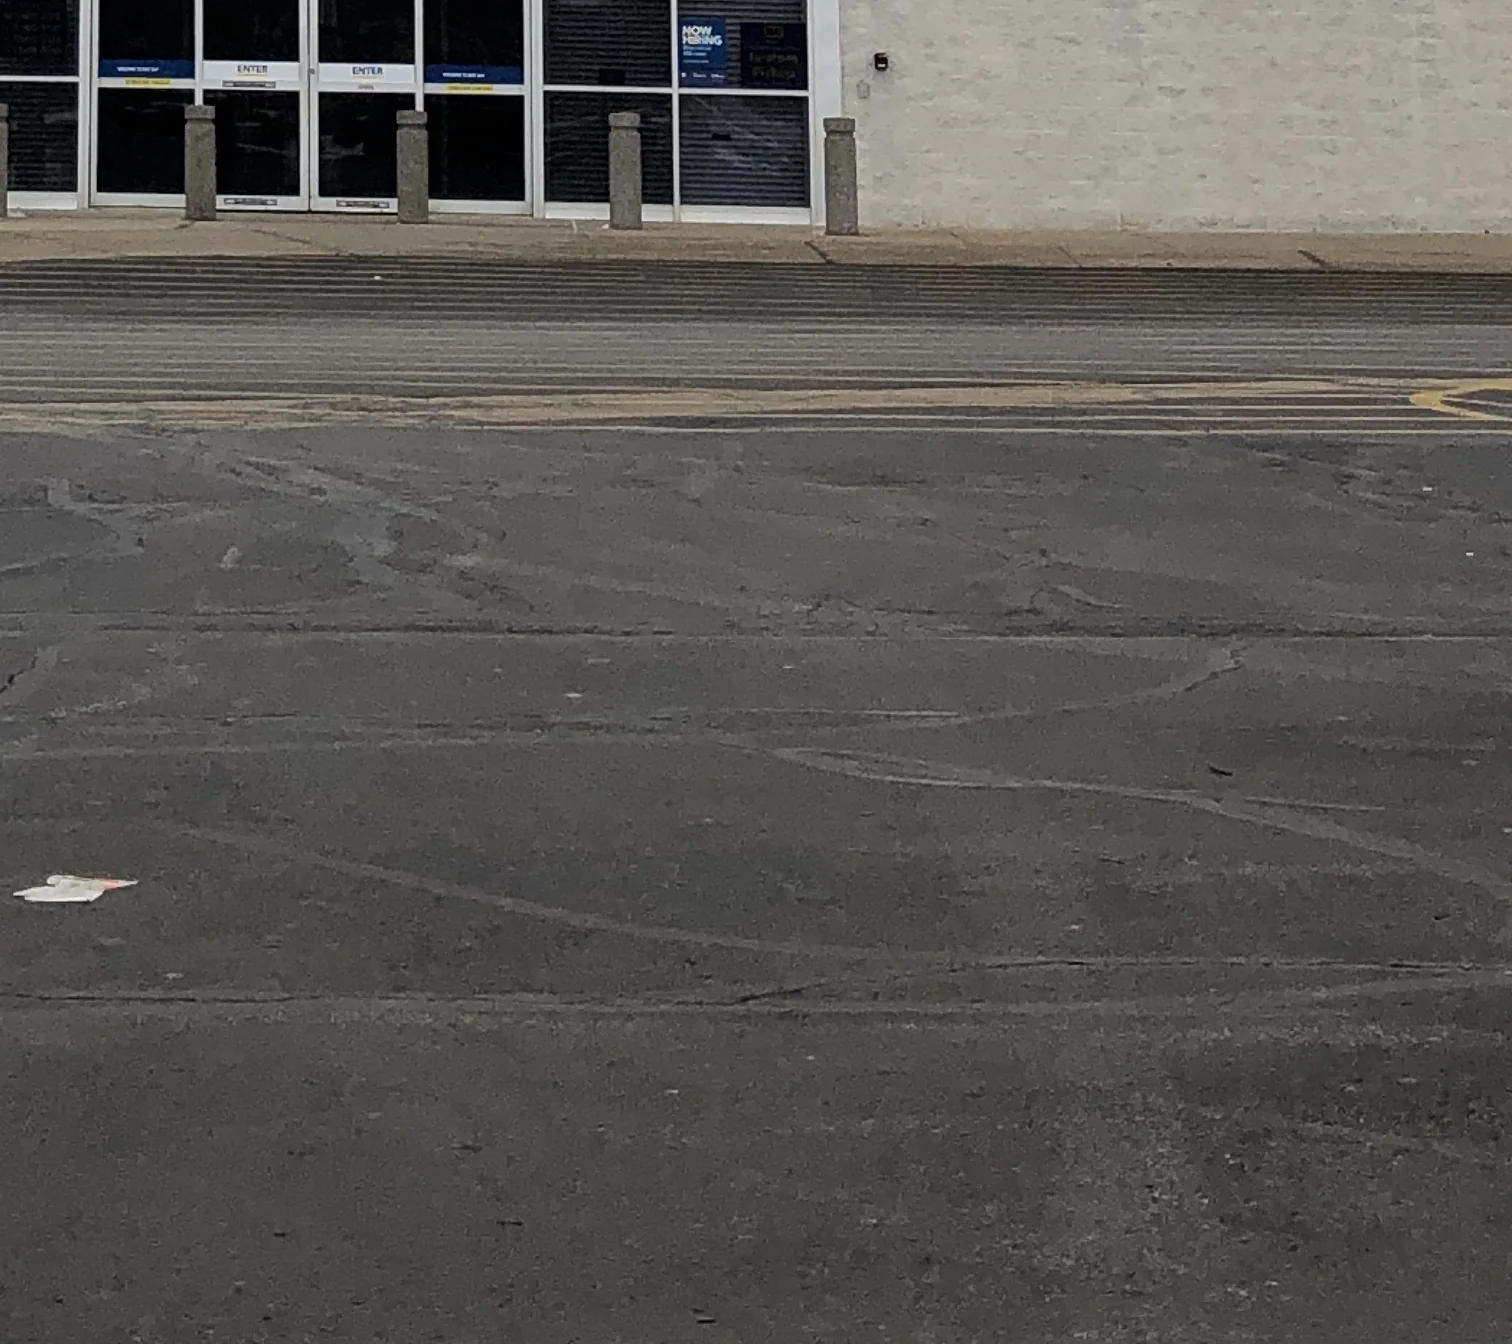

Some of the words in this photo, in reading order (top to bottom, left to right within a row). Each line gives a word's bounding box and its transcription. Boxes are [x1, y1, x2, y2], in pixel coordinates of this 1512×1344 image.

[682, 25, 713, 35] NOW
[238, 65, 268, 73] ENTER
[352, 66, 384, 75] ENTER
